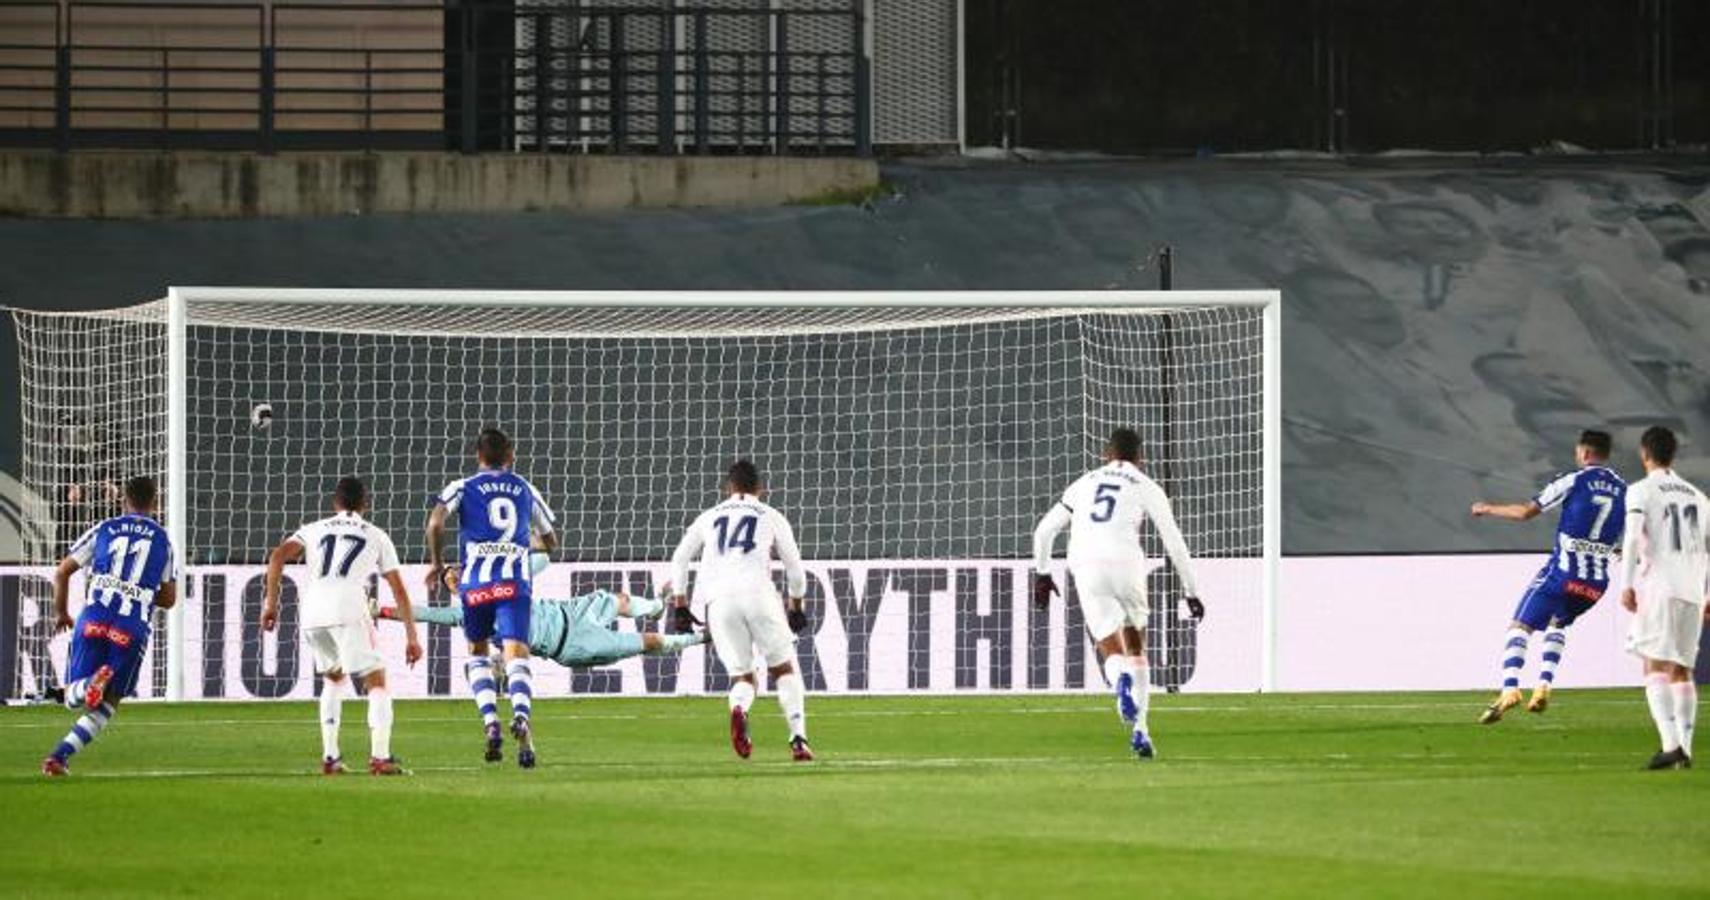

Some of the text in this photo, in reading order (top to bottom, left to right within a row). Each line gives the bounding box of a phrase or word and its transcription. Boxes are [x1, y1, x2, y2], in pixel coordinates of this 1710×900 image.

[487, 497, 518, 542] 9
[1090, 483, 1121, 523] 5
[1591, 494, 1613, 540] 7
[713, 514, 758, 556] 14
[1662, 503, 1699, 551] 11
[108, 536, 152, 584] 11
[318, 533, 367, 578] 17
[570, 567, 1198, 693] EVRYTHIG
